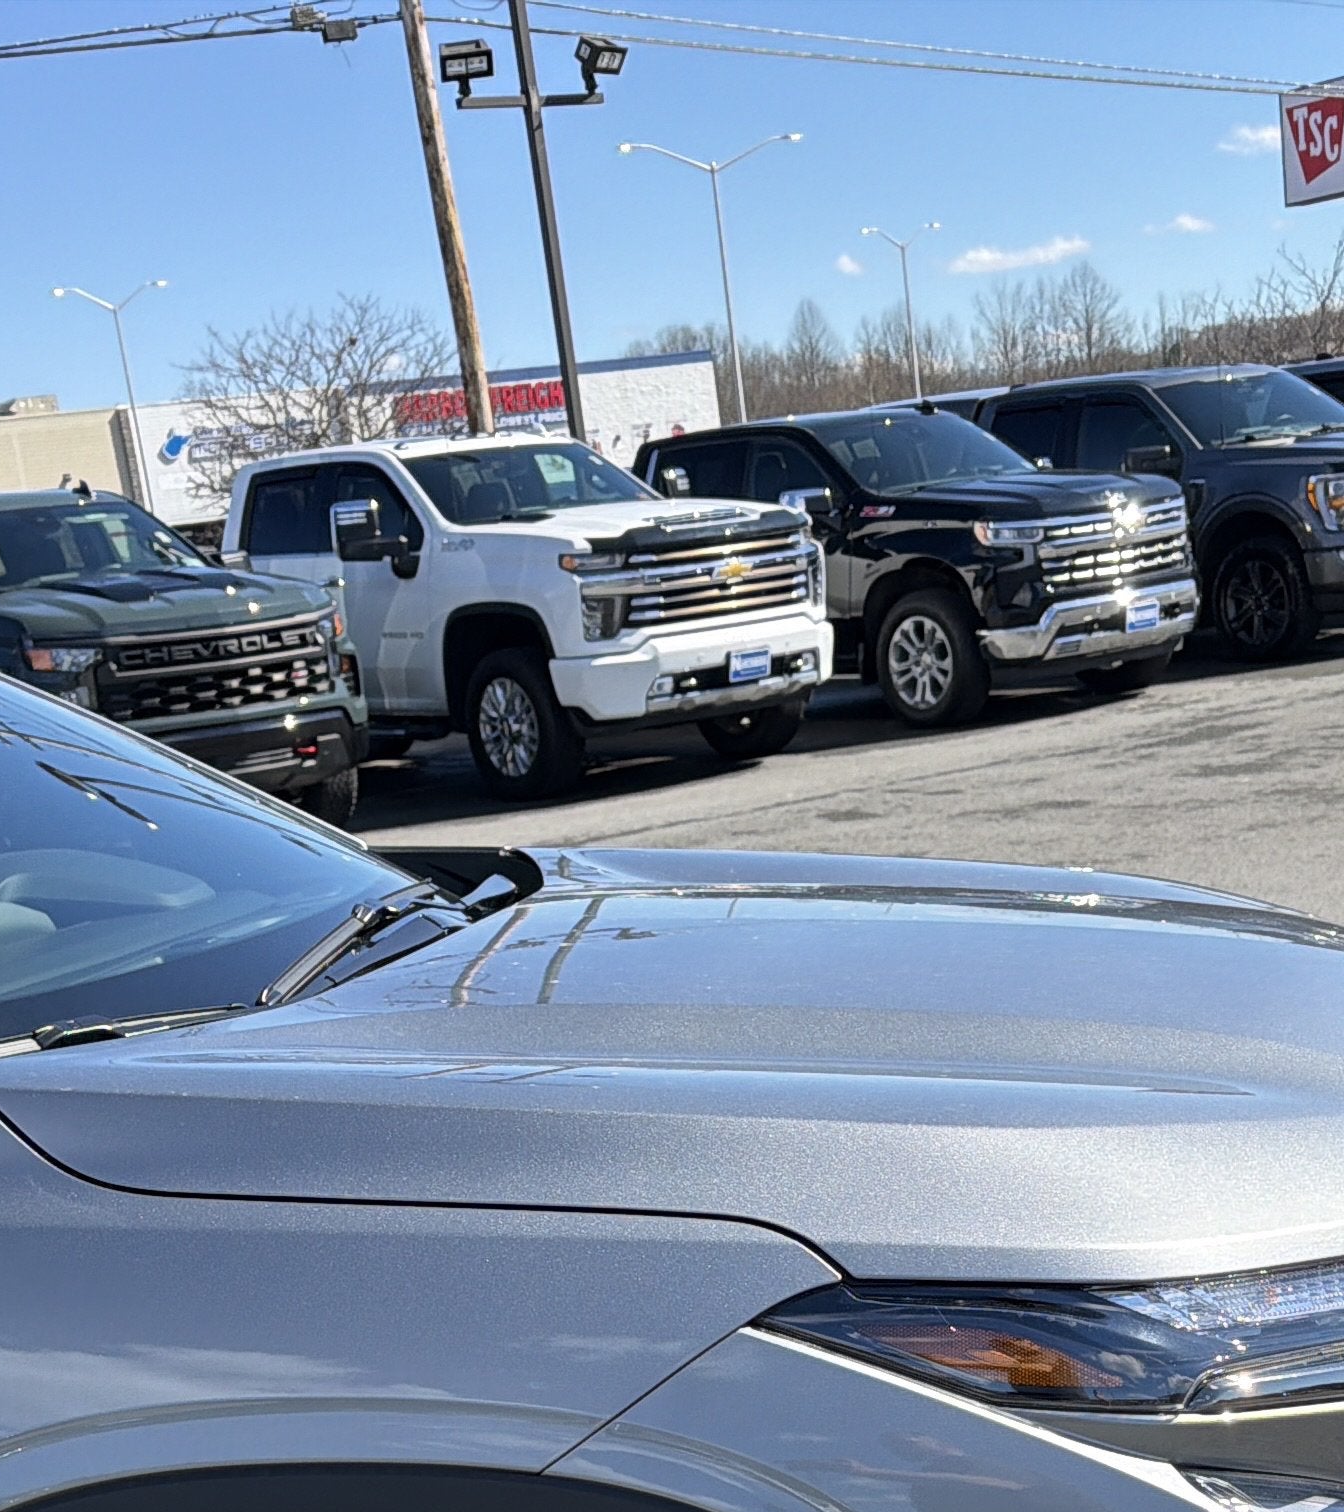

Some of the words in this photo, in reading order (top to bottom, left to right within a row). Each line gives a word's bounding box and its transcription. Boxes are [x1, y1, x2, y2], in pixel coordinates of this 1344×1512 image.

[1292, 106, 1338, 162] TSC
[491, 380, 565, 414] FREIGH
[118, 626, 317, 666] CHEVROLET
